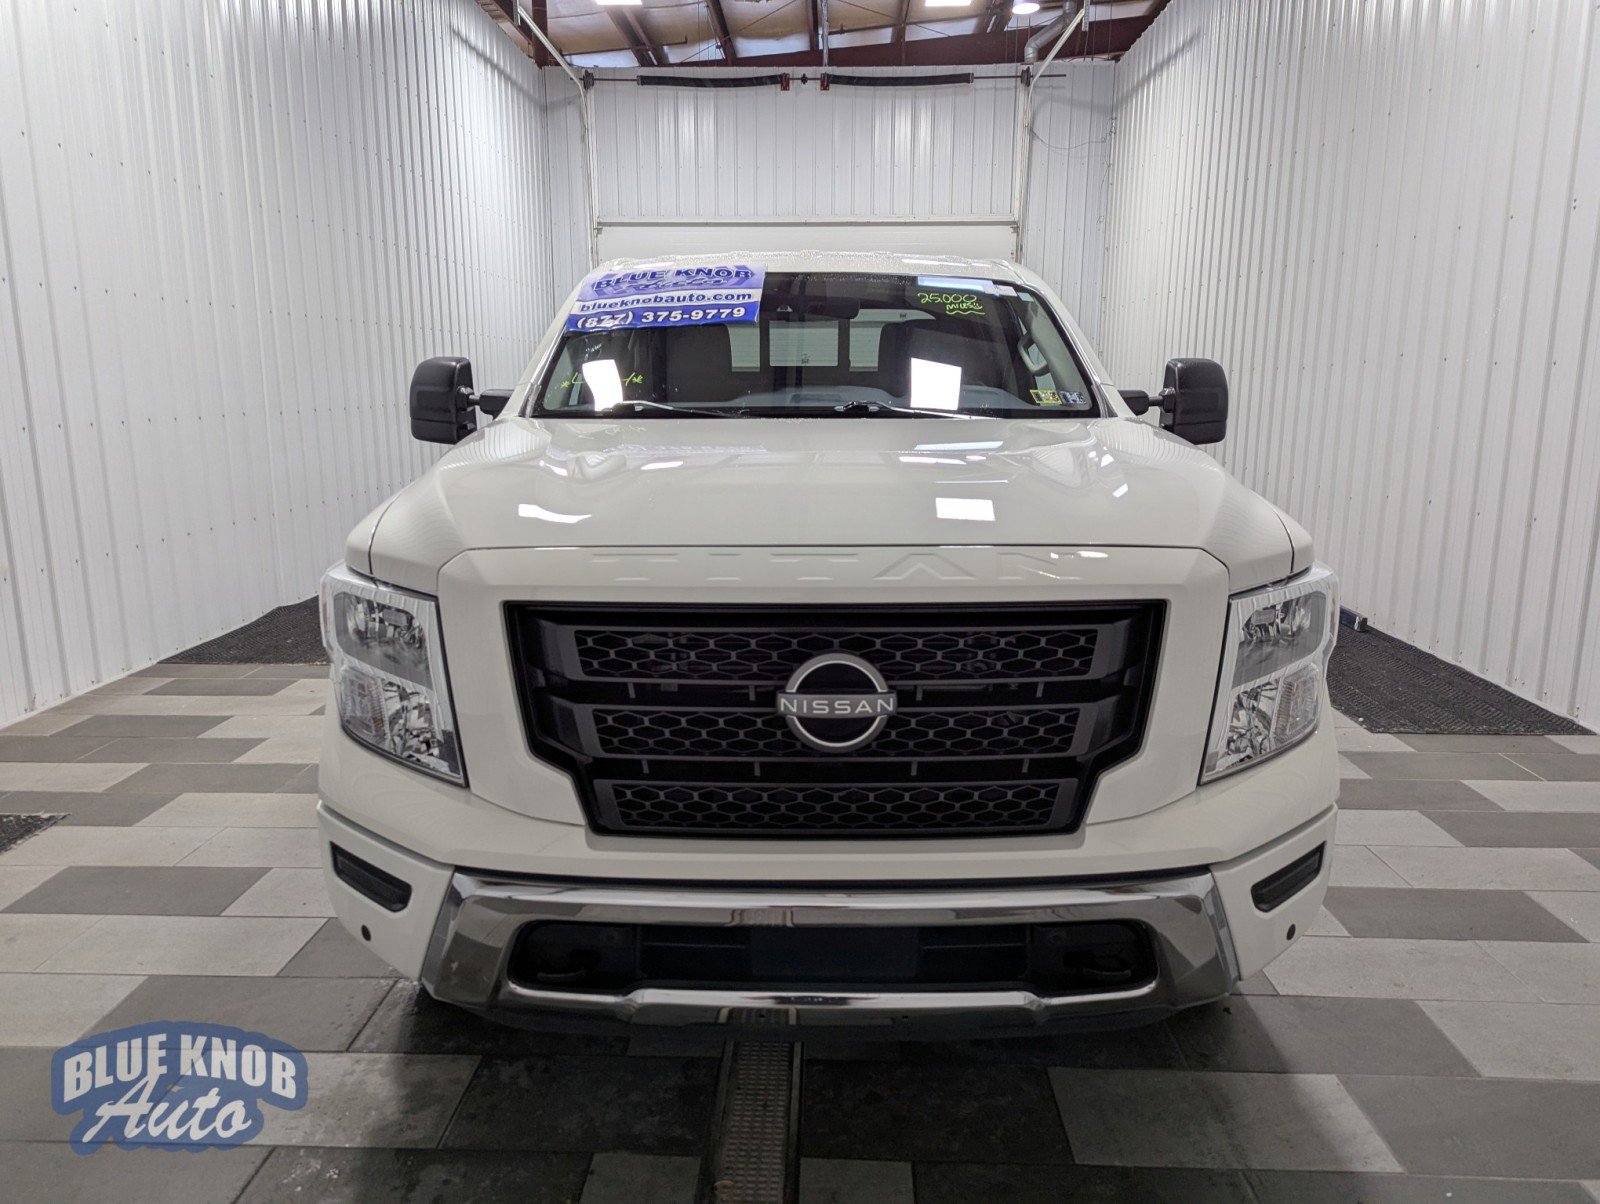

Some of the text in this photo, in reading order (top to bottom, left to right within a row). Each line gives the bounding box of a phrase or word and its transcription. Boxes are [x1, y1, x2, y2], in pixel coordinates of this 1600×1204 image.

[594, 268, 752, 290] BLUE KNOB
[580, 293, 752, 312] blueknobauto.com
[641, 307, 746, 323] 375-9779
[780, 698, 894, 714] NISSAN
